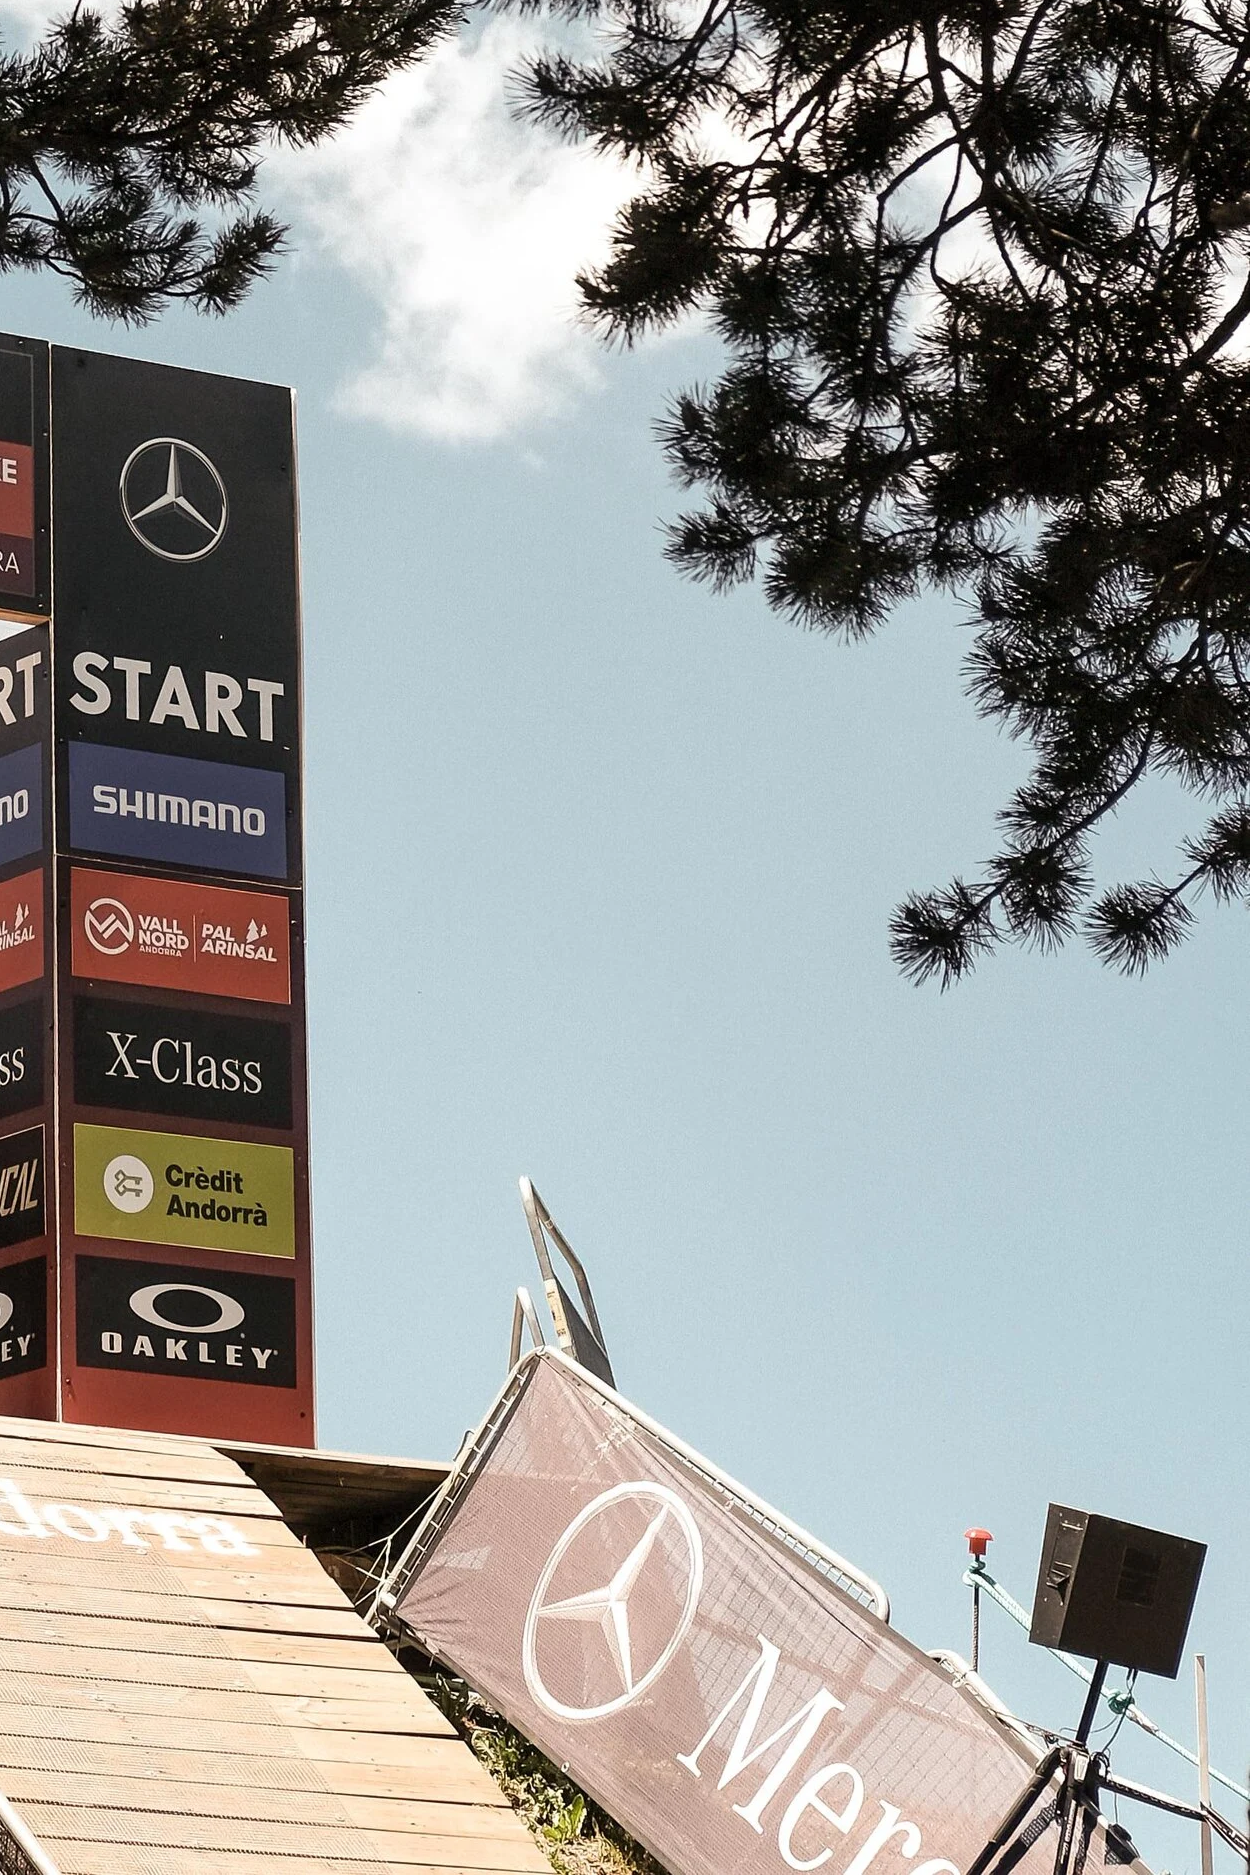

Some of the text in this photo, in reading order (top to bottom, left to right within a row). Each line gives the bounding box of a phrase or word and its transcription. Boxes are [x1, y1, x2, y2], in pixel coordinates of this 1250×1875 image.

[69, 651, 285, 742] START
[92, 784, 267, 837] SHIMANO
[138, 914, 183, 935] VALL
[138, 929, 190, 951] NORD
[201, 923, 236, 942] PAL
[139, 945, 183, 958] ANDORRA
[200, 941, 278, 963] ARINSAL
[104, 1030, 264, 1095] X-Class
[164, 1163, 245, 1196] Crèdit
[165, 1195, 269, 1228] Andorrà
[101, 1331, 273, 1369] OAKLEY
[675, 1632, 962, 1875] Mer
